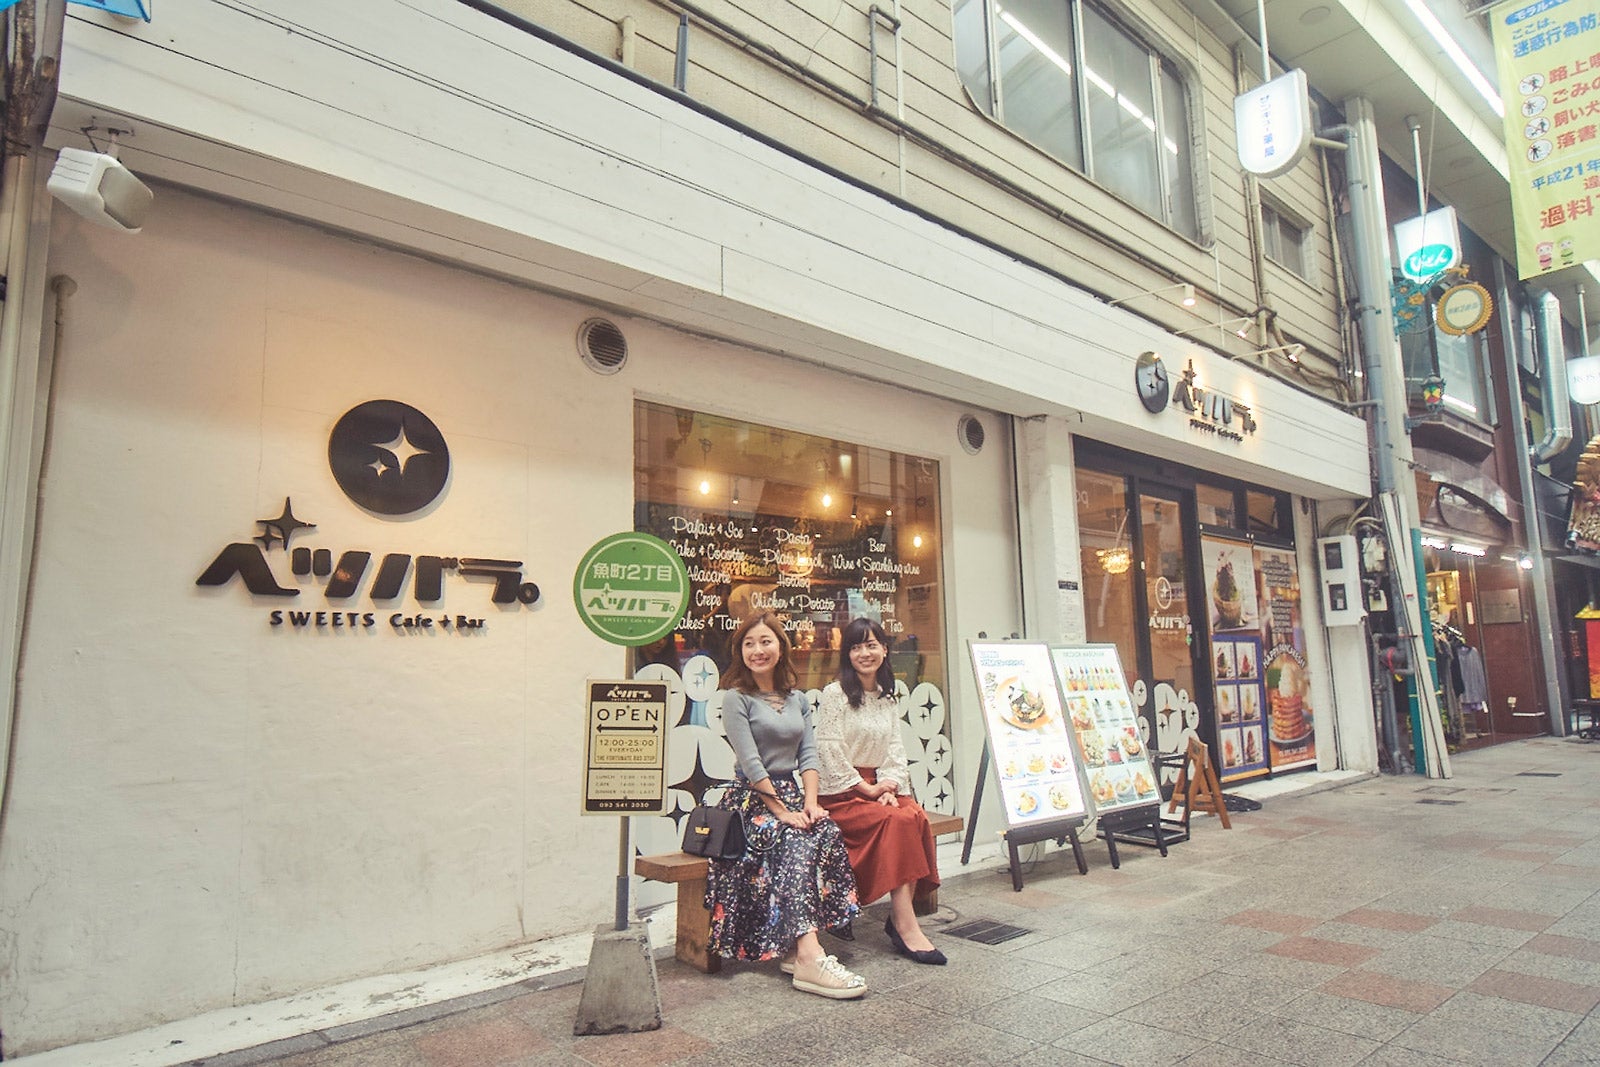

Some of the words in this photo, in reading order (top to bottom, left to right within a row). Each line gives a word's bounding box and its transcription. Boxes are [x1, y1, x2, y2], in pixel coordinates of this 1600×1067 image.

[1515, 0, 1567, 20] モラル・
[1513, 12, 1600, 58] 迷惑行為防
[1540, 194, 1600, 230] 過料
[774, 528, 811, 546] Pasta
[867, 538, 887, 553] Beer
[593, 563, 673, 582] 魚町2丁目
[861, 577, 897, 593] Cocktail
[695, 589, 722, 610] Crepe
[751, 590, 789, 610] Chicken
[796, 594, 836, 613] Potato
[270, 609, 376, 629] SWEETS
[389, 611, 433, 630] Cafe
[456, 613, 487, 631] Bar
[673, 611, 705, 631] akes
[715, 614, 744, 631] Tart
[886, 619, 904, 633] Tea
[597, 708, 659, 721] OPEN
